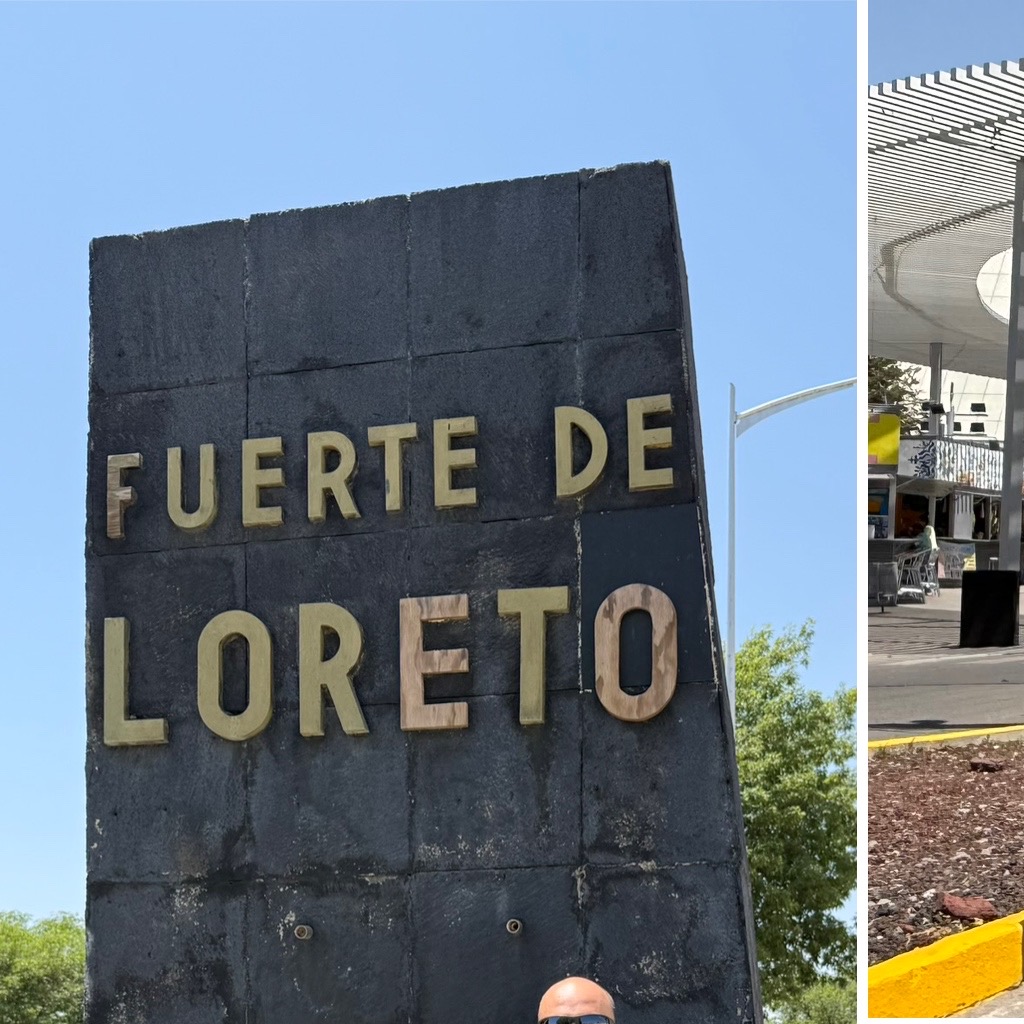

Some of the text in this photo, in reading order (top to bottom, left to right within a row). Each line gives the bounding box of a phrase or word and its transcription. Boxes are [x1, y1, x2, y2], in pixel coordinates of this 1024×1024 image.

[106, 393, 674, 539] FUERTE DE
[103, 582, 678, 746] LORETO
